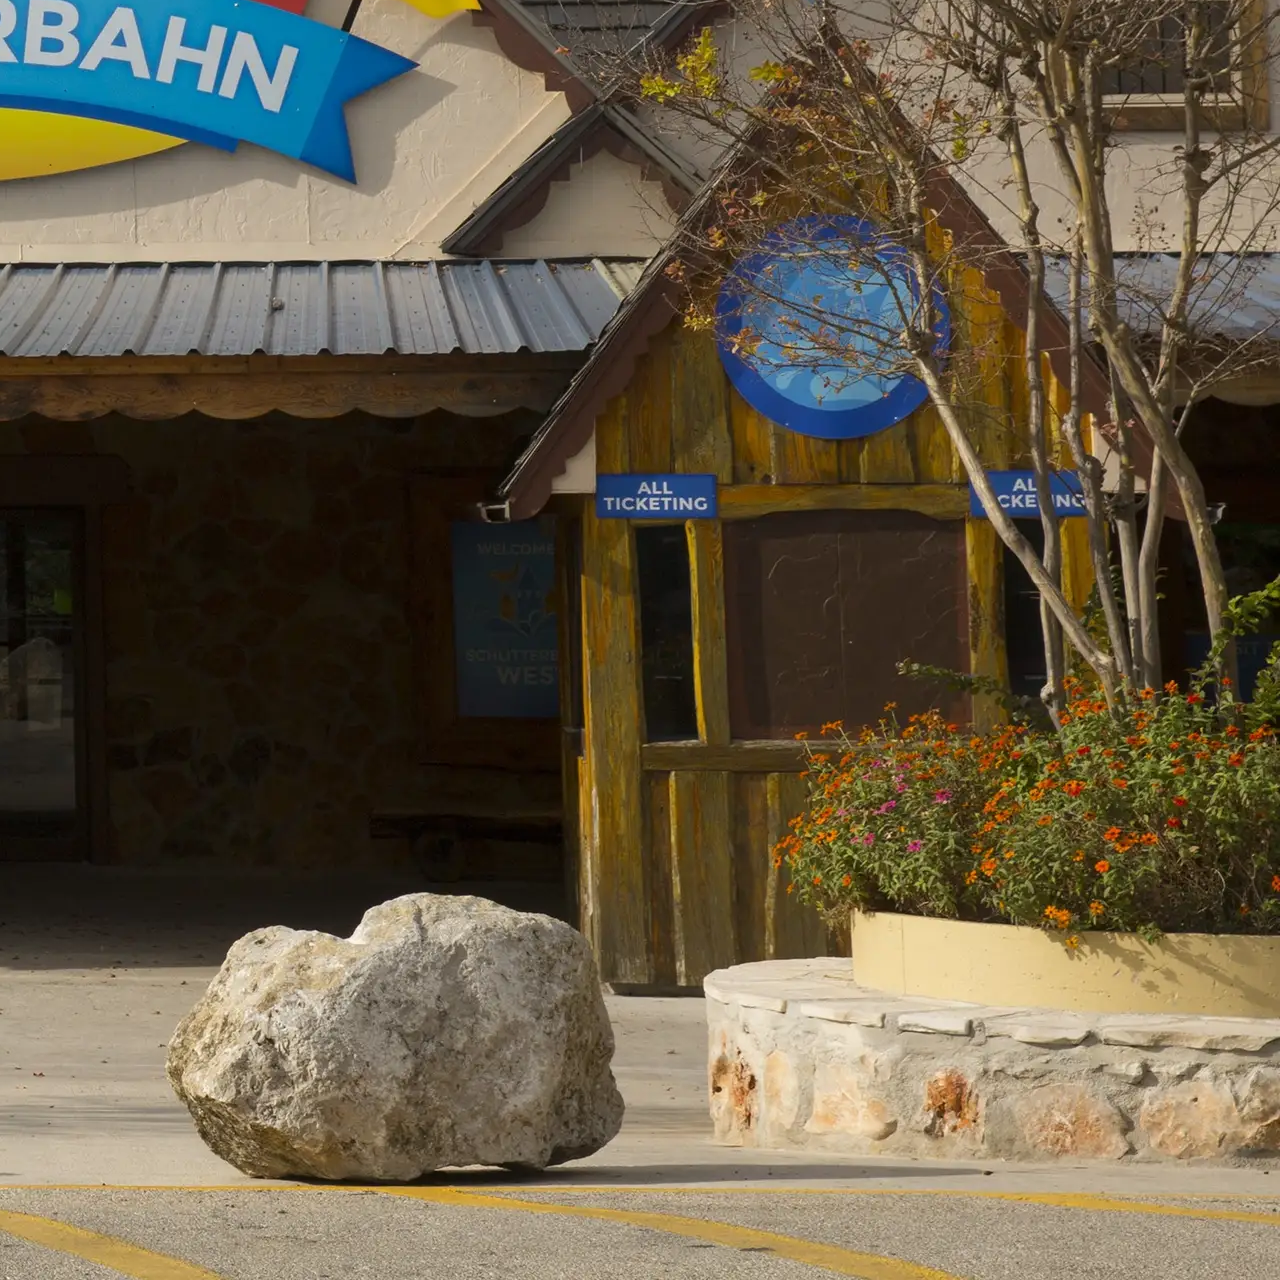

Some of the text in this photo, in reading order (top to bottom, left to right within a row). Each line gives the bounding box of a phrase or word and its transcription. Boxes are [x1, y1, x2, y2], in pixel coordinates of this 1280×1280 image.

[637, 482, 673, 494] ALL
[1012, 478, 1037, 492] AL
[604, 497, 708, 511] TICKETING
[477, 542, 555, 555] WELCOME
[465, 648, 559, 662] SCHLITTERB
[496, 666, 559, 685] WES
